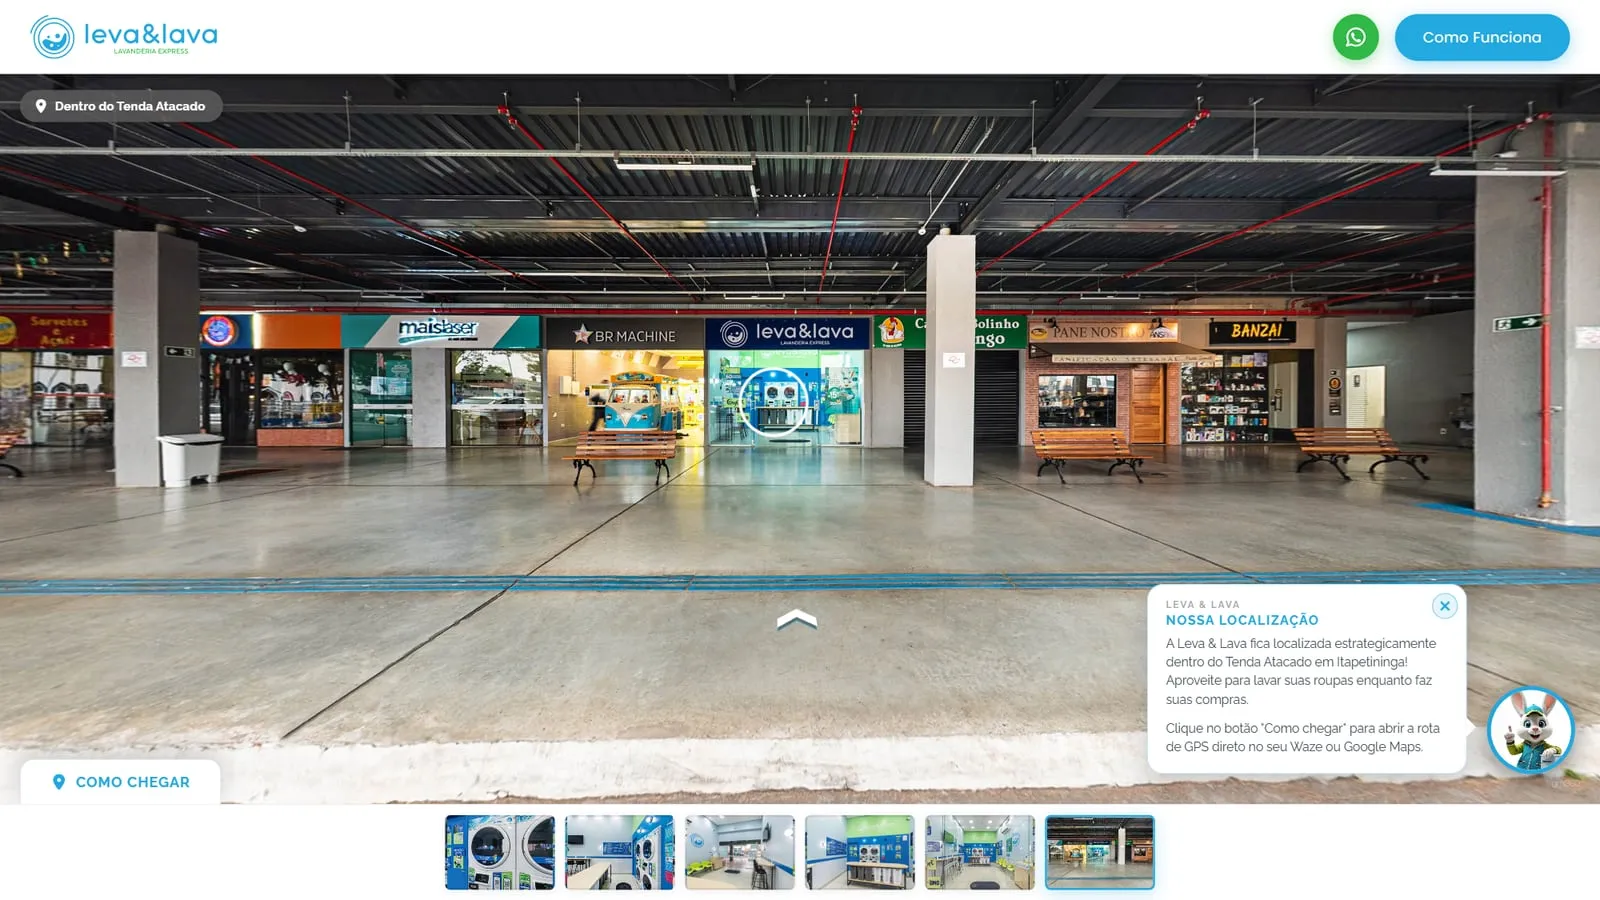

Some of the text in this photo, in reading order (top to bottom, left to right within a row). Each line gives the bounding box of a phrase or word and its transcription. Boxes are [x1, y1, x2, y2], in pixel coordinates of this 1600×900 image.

[595, 330, 676, 342] BR MACHINE
[756, 323, 854, 339] leva&lava
[1053, 326, 1145, 338] PANE NOSTO
[1231, 323, 1282, 338] BANZAI
